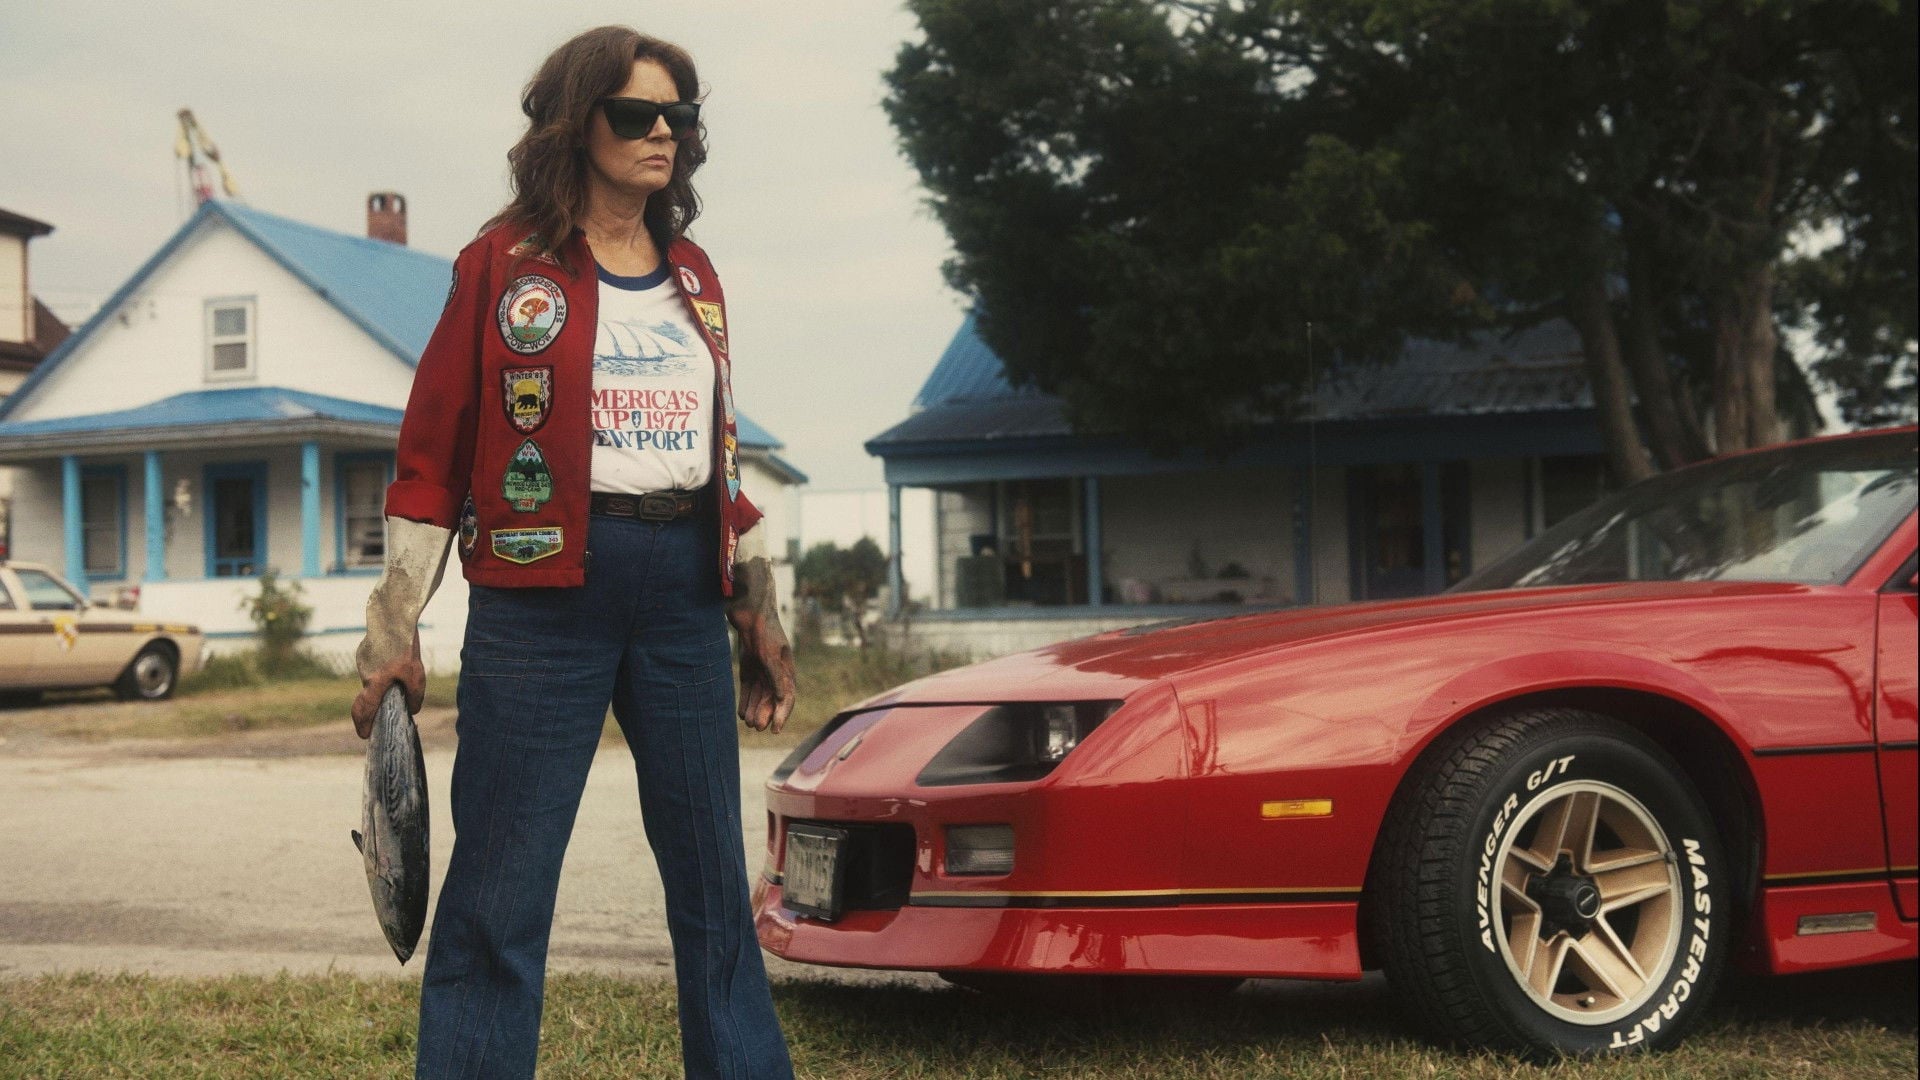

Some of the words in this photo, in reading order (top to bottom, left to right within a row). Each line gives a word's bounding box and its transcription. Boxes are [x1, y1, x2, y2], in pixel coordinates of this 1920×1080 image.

[506, 333, 552, 350] POW-WOW
[510, 372, 533, 380] WINTER
[591, 389, 699, 410] MERICA'S
[592, 410, 630, 430] UP
[644, 410, 691, 430] 1977
[592, 429, 698, 450] EWPORT
[1477, 793, 1517, 953] AVENGER
[1526, 754, 1576, 791] G/T
[1609, 838, 1711, 1049] MASTERCRAFT
